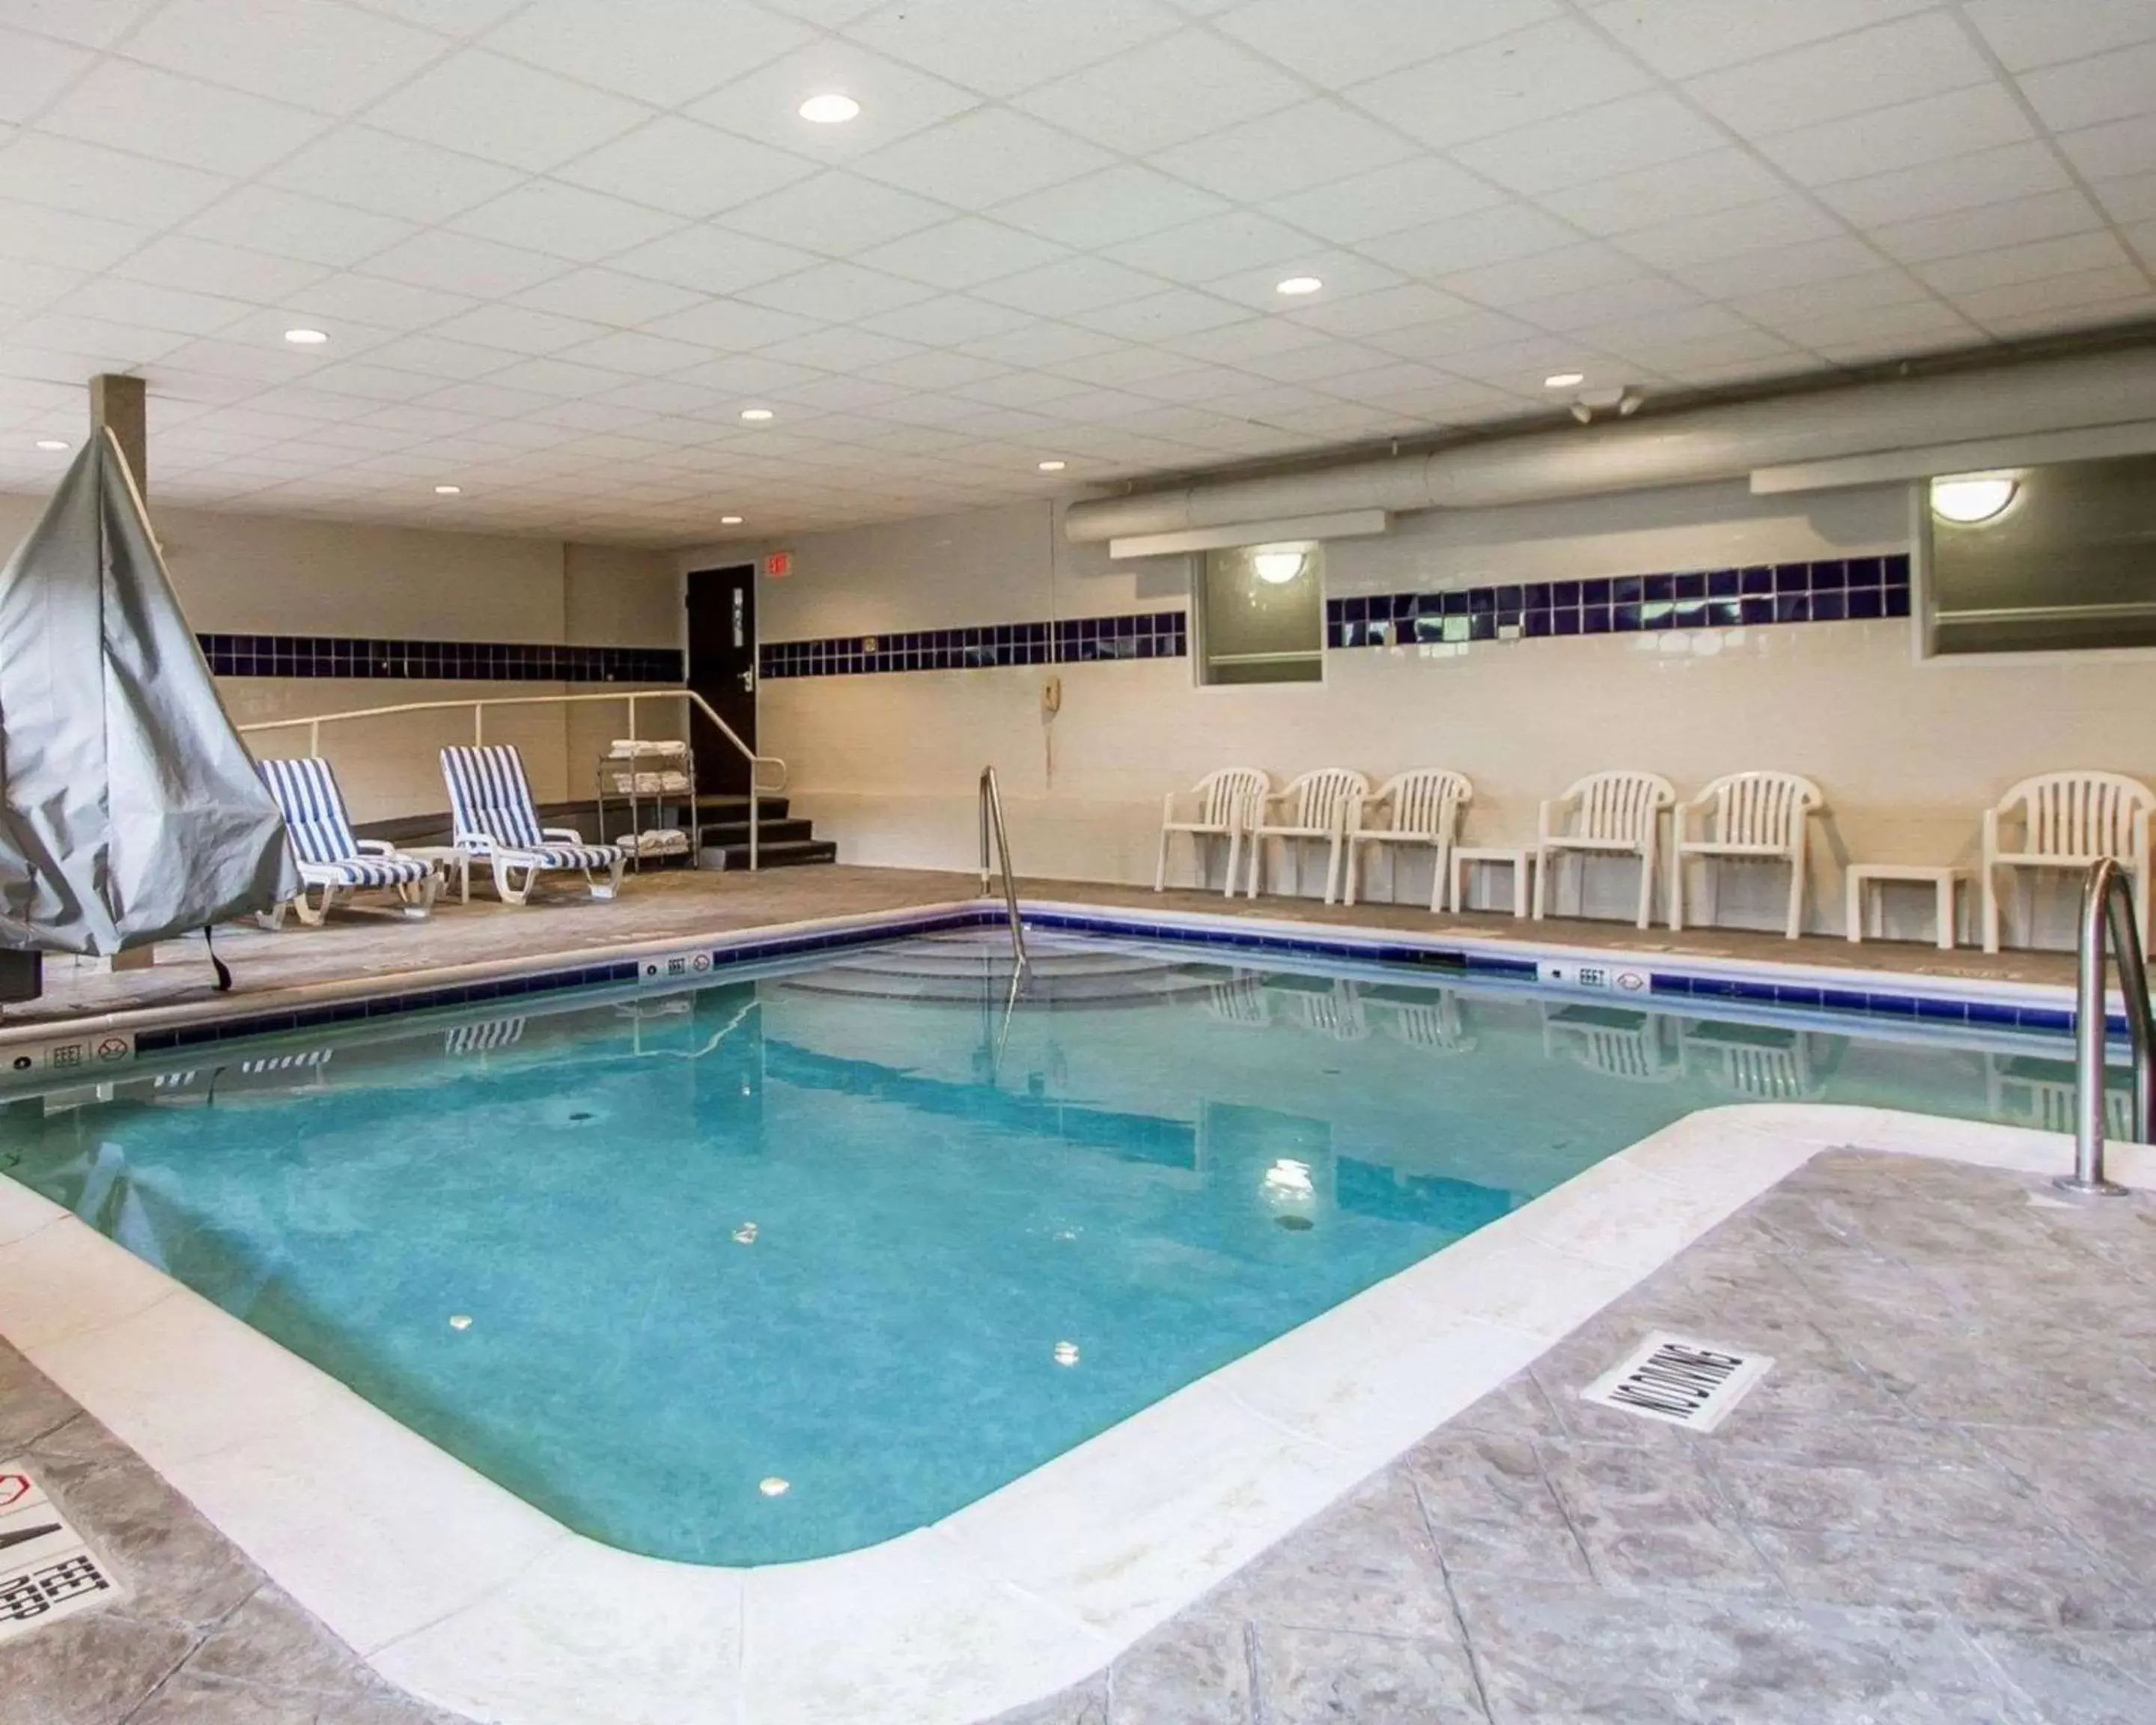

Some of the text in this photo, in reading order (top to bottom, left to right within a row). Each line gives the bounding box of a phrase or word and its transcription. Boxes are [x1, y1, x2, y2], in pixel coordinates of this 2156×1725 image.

[1607, 1343, 1744, 1420] NO DIVING
[33, 1555, 110, 1604] FEET
